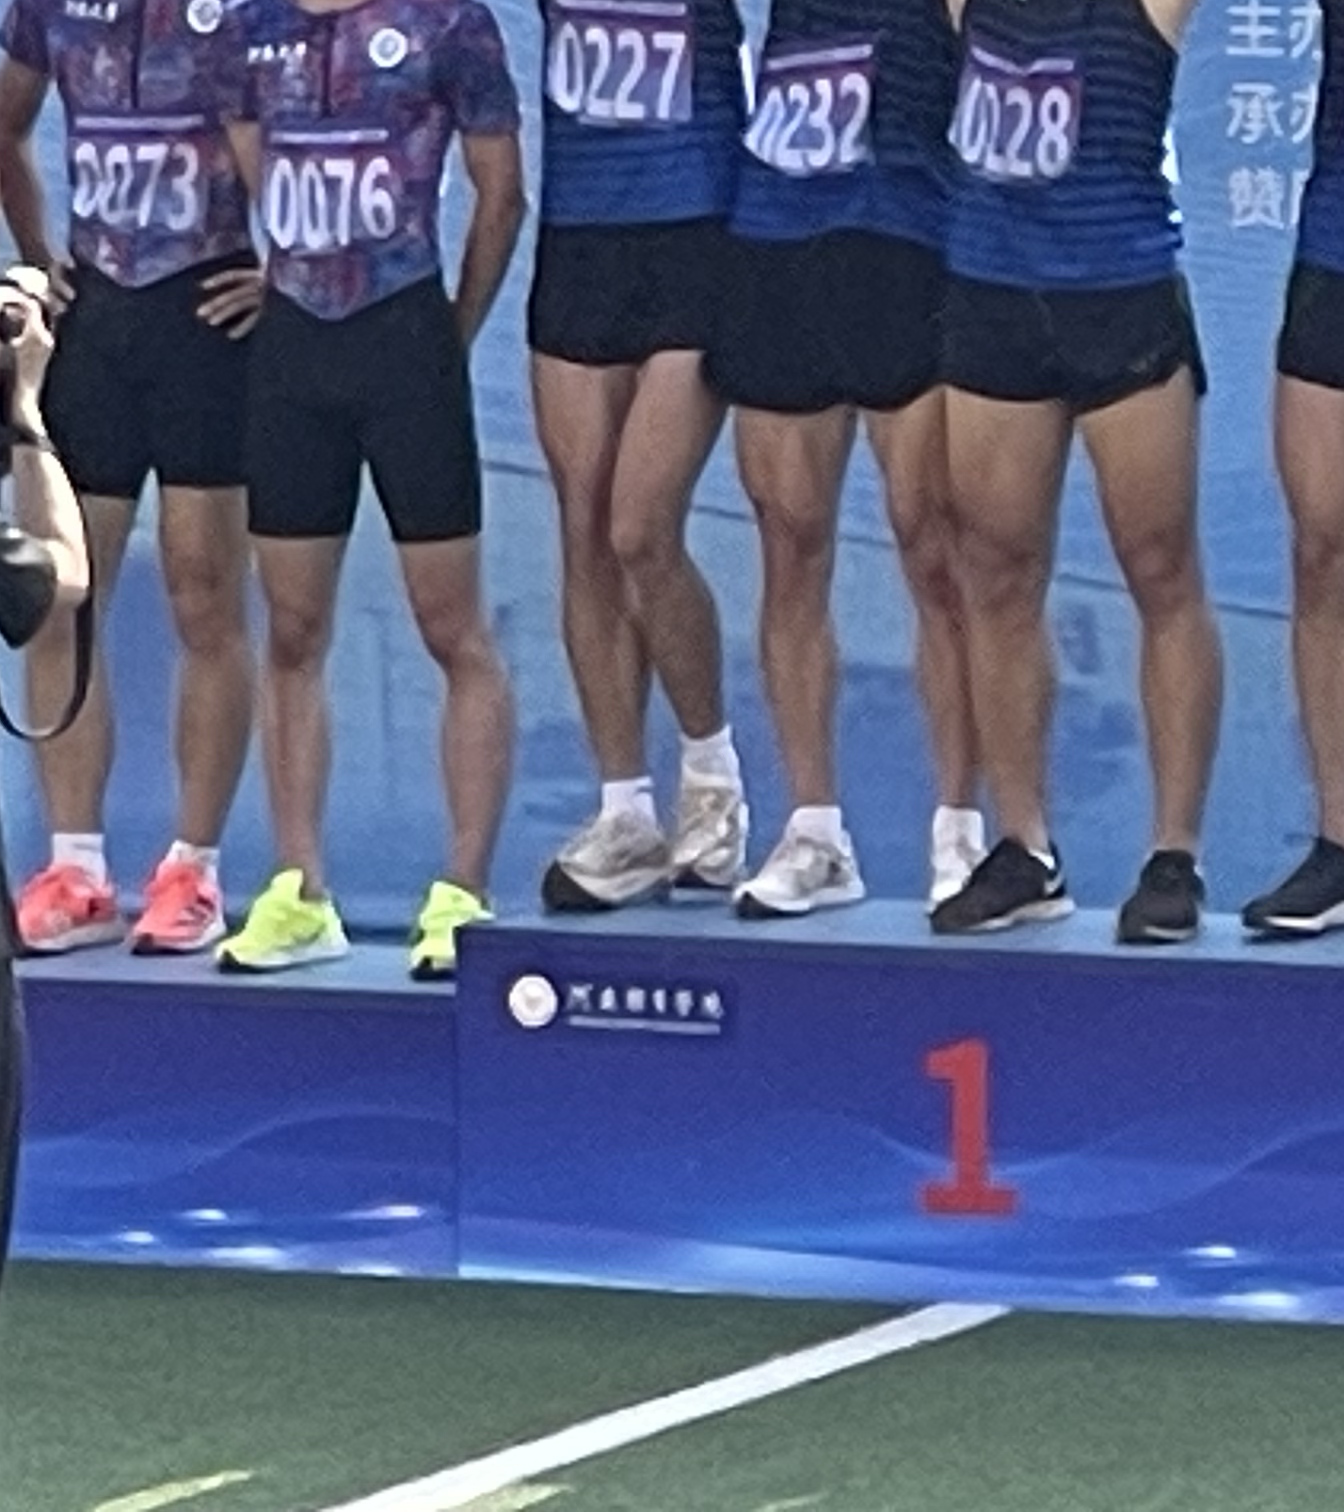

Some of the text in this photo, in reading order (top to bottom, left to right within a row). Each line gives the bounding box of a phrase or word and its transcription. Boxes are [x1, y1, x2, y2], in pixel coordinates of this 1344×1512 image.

[547, 21, 686, 121] 0227
[744, 73, 872, 172] 0232
[960, 77, 1071, 179] 0228
[72, 141, 199, 232] 0073
[267, 155, 397, 250] 0076
[919, 1038, 1021, 1216] 1
